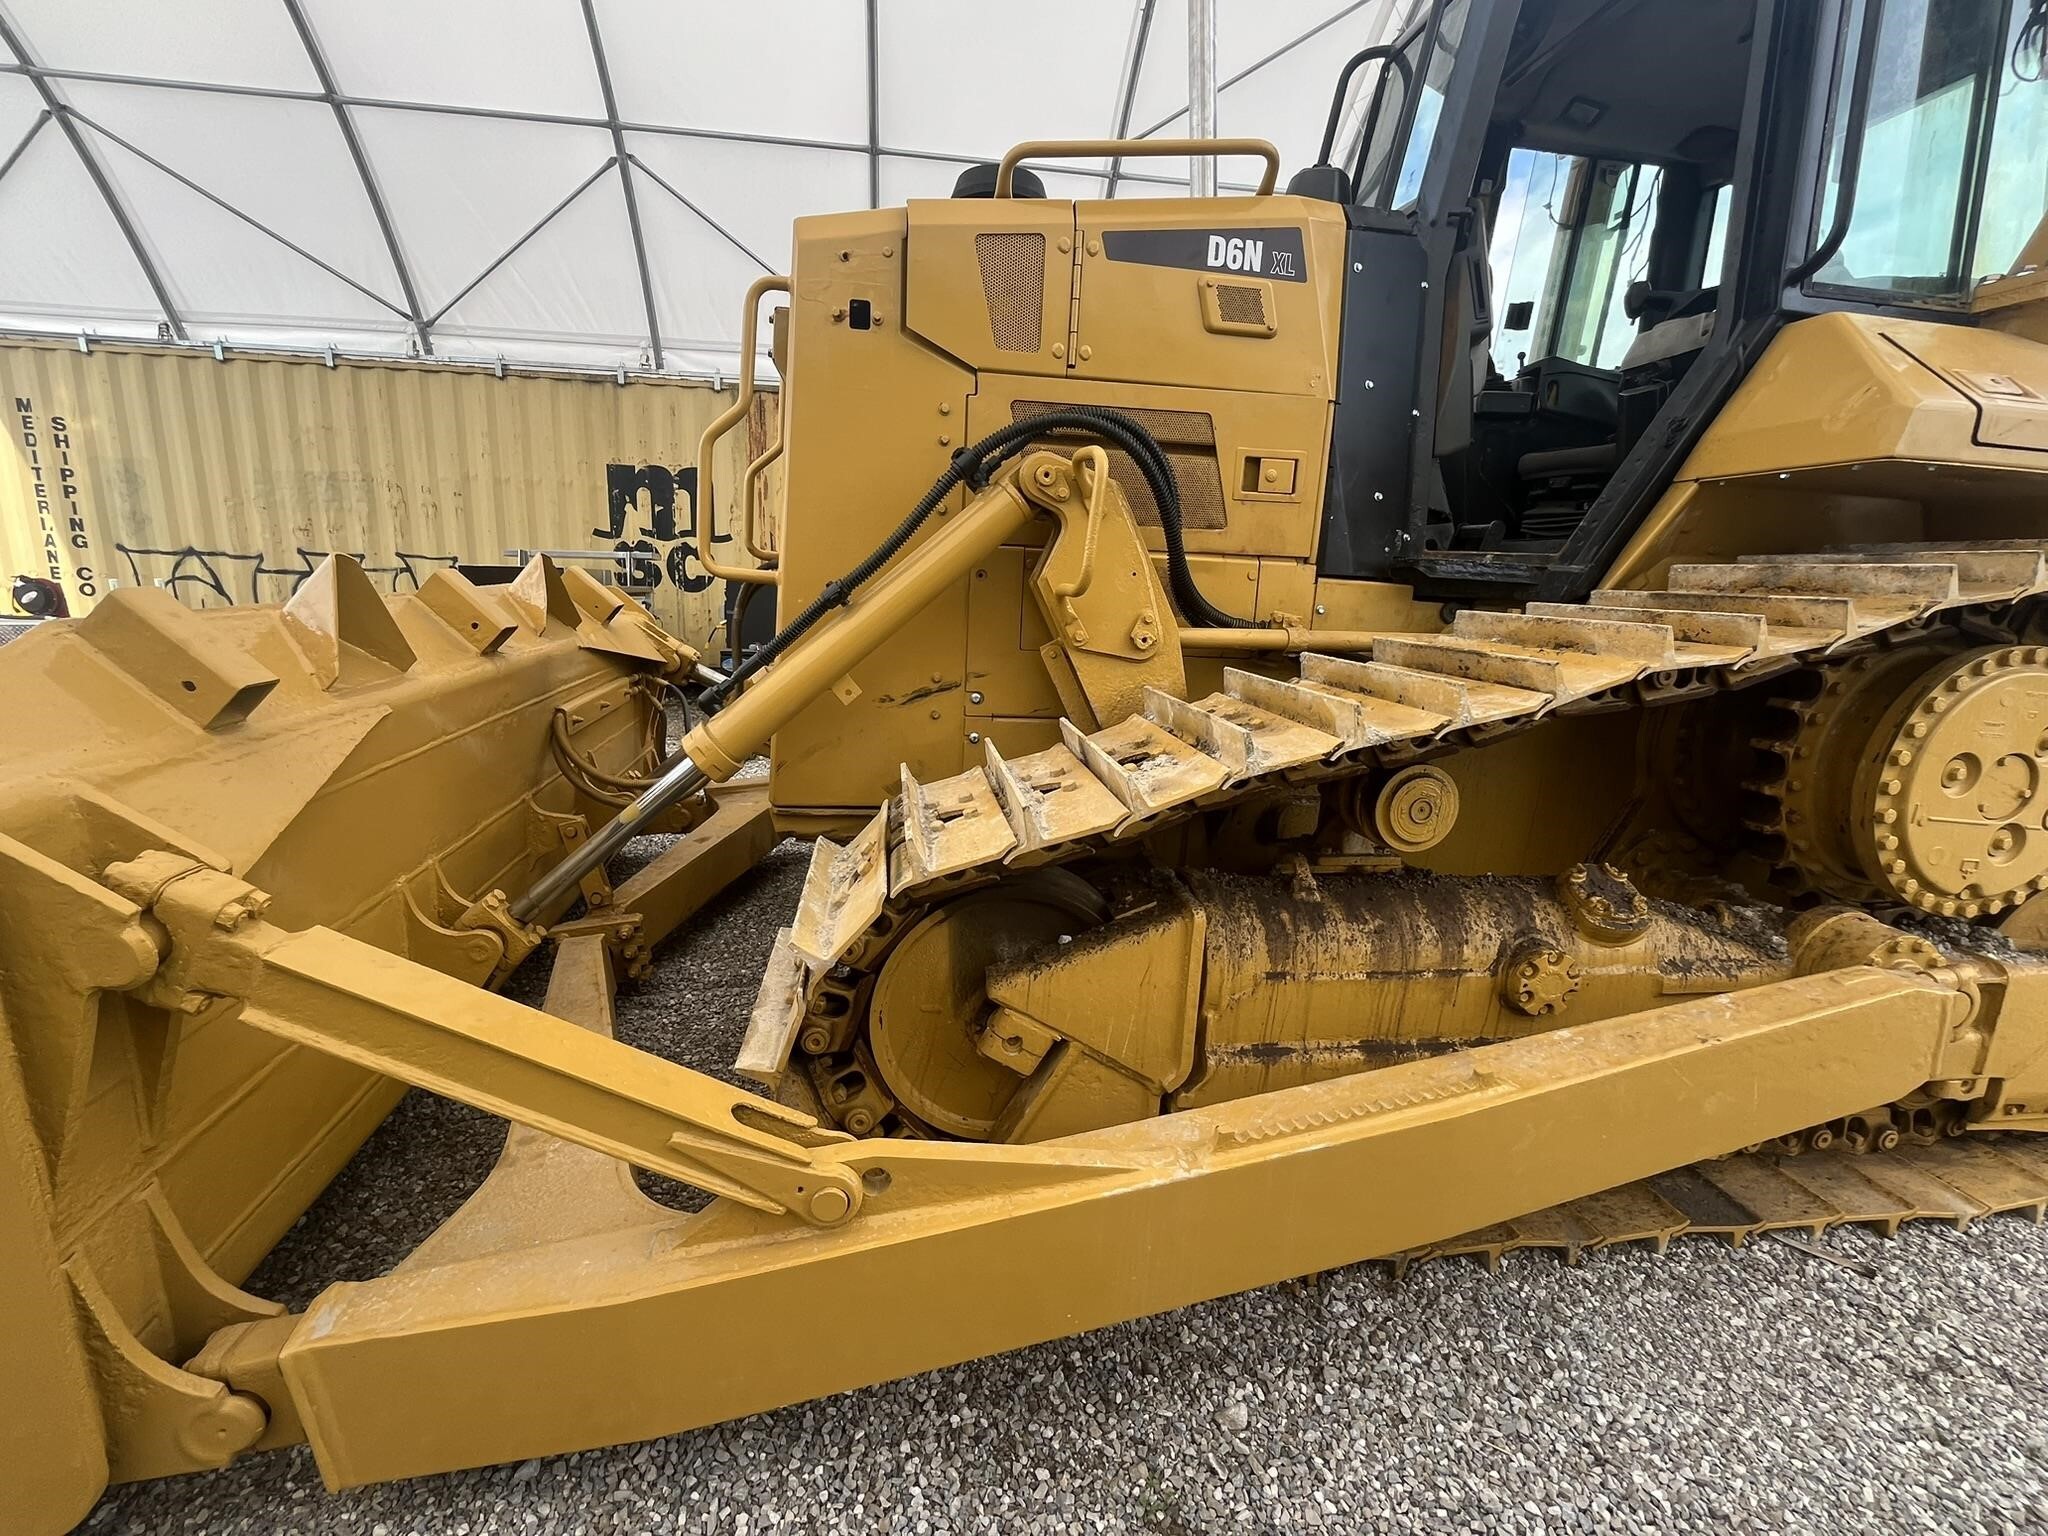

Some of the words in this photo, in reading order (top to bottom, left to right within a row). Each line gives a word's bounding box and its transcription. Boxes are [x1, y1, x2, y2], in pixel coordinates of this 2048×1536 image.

[1207, 235, 1263, 273] D6N
[1270, 251, 1295, 277] XL
[51, 416, 89, 549] SHIPPING
[76, 567, 96, 597] CO
